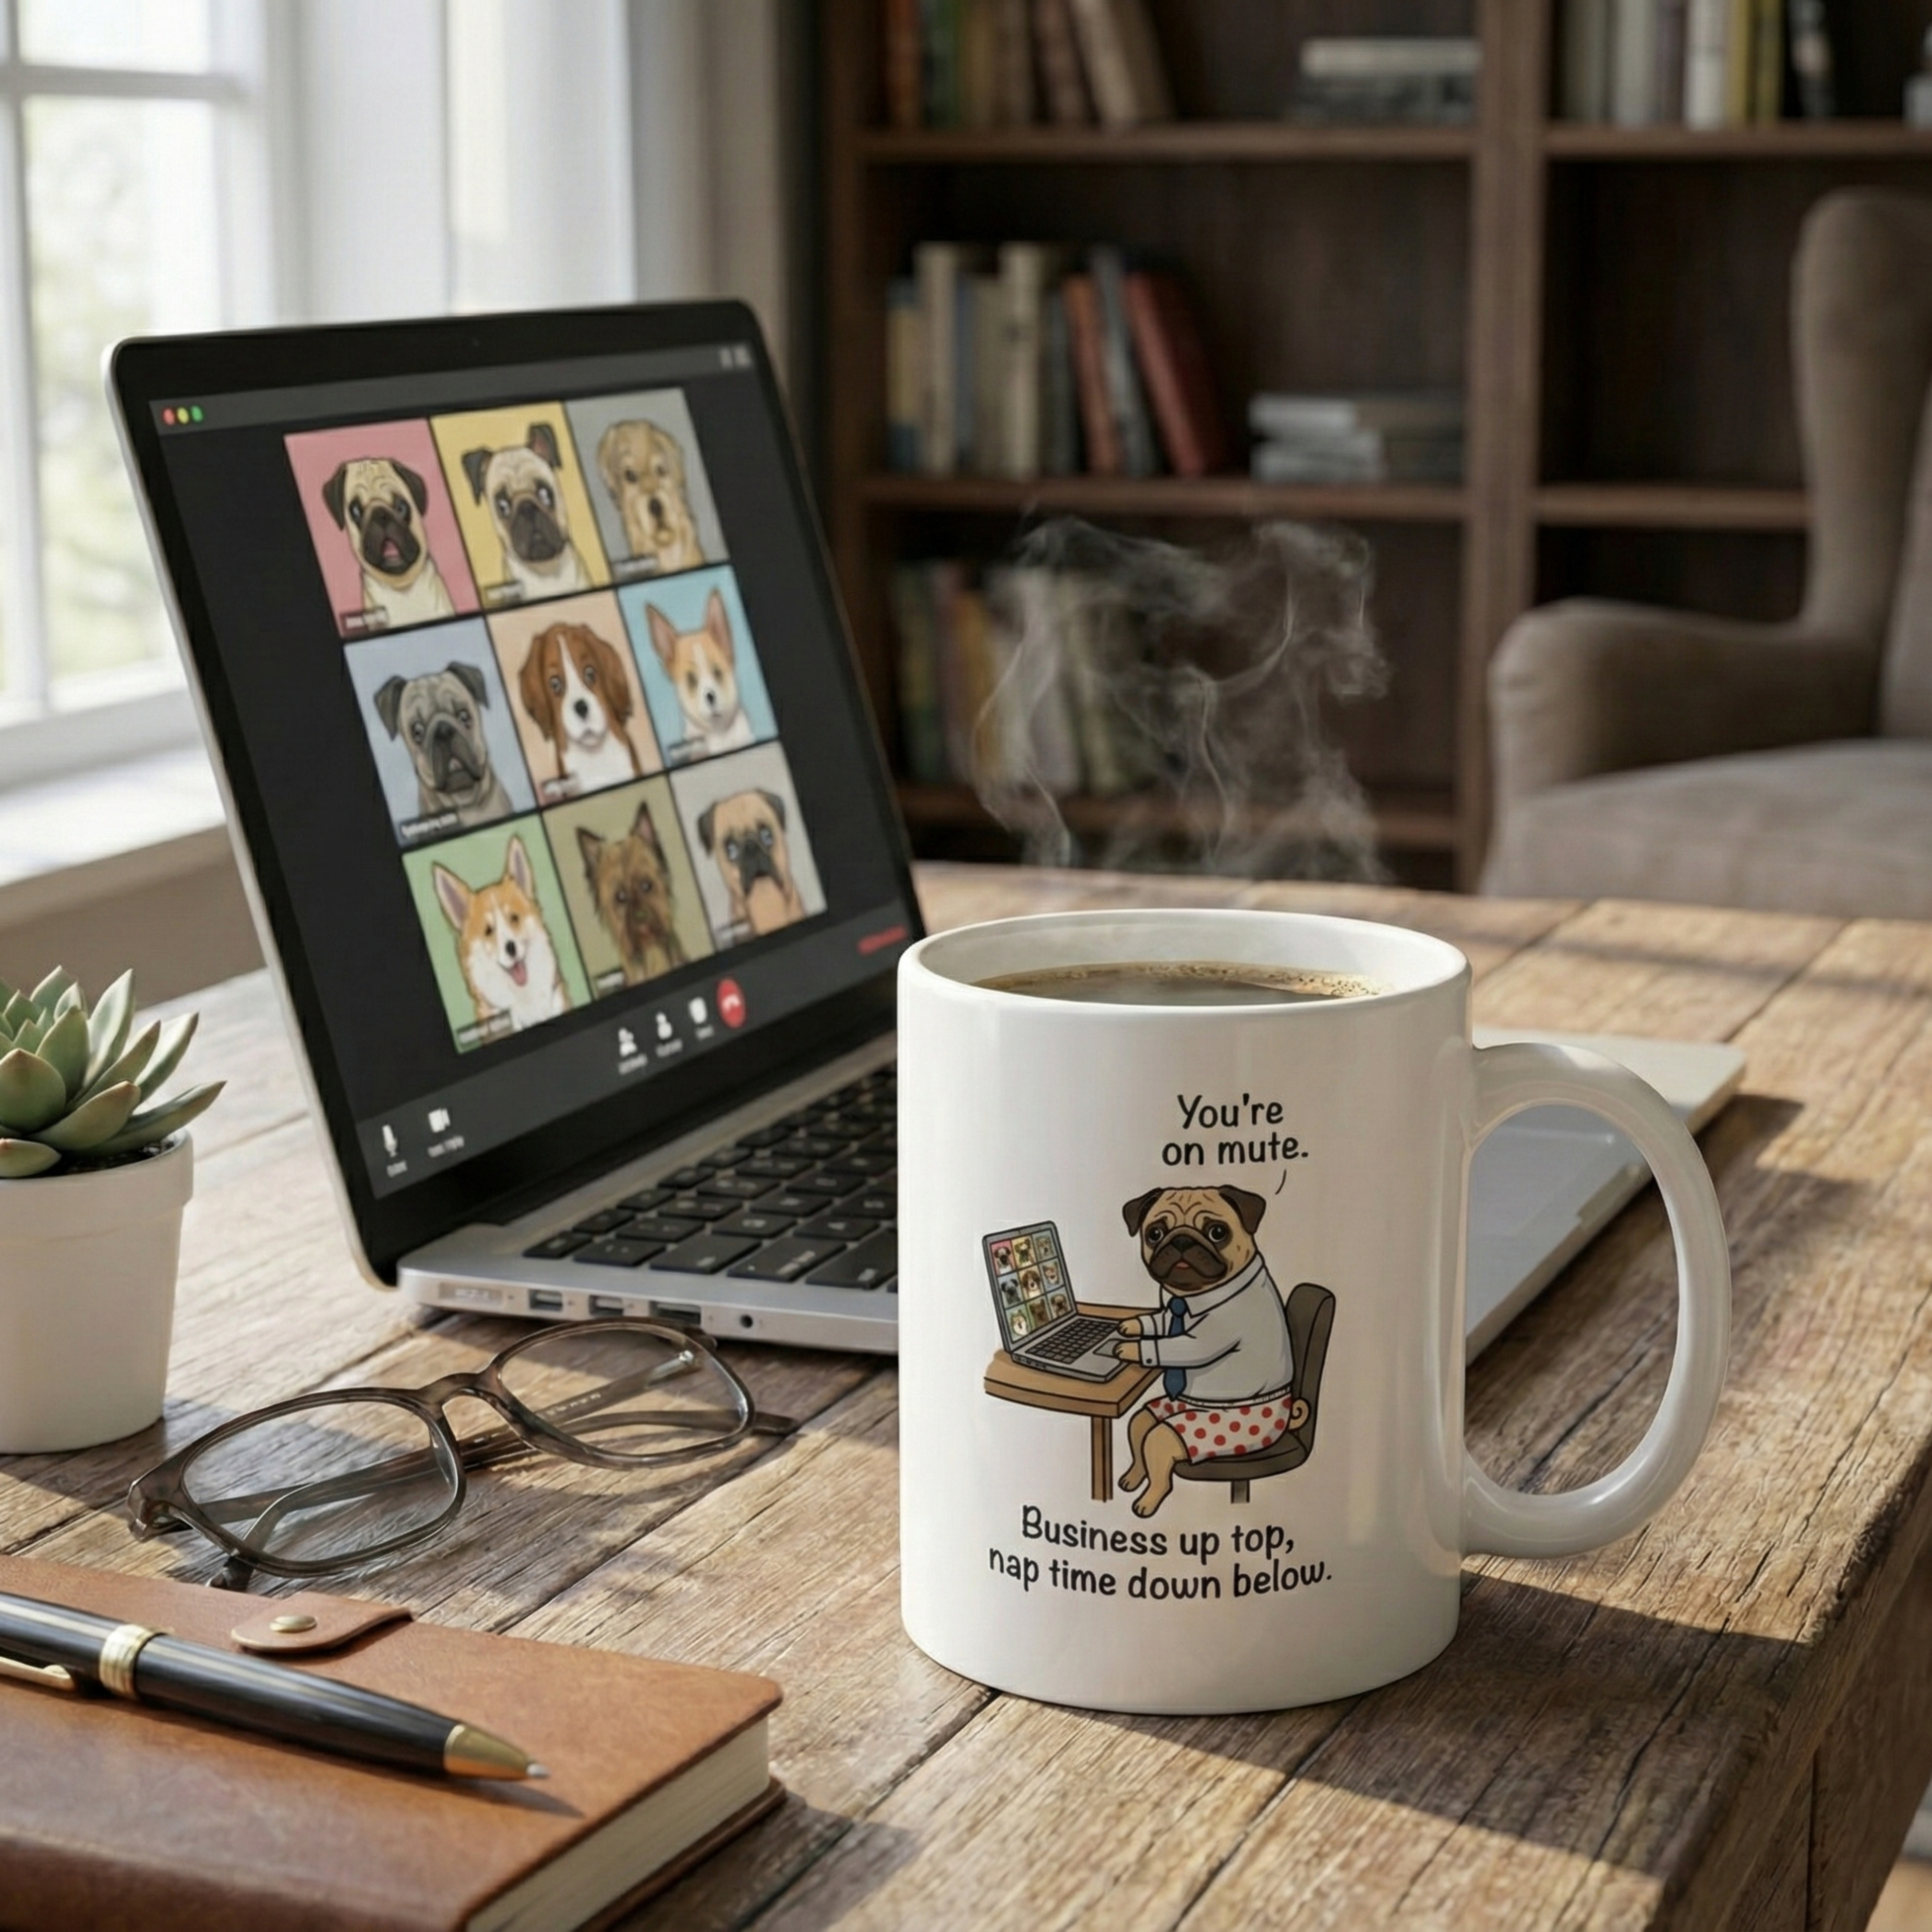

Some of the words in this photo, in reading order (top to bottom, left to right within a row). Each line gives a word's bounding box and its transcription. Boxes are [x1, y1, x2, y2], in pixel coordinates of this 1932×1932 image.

[1177, 1092, 1284, 1130] You're
[1162, 1142, 1204, 1166] on
[1218, 1132, 1309, 1165] mute.
[1022, 1504, 1168, 1556] Business
[1179, 1532, 1221, 1566] up
[1231, 1524, 1295, 1561] top,
[989, 1547, 1039, 1592] nap
[1048, 1559, 1117, 1596] time
[1128, 1566, 1222, 1600] down
[1232, 1557, 1333, 1598] below.
